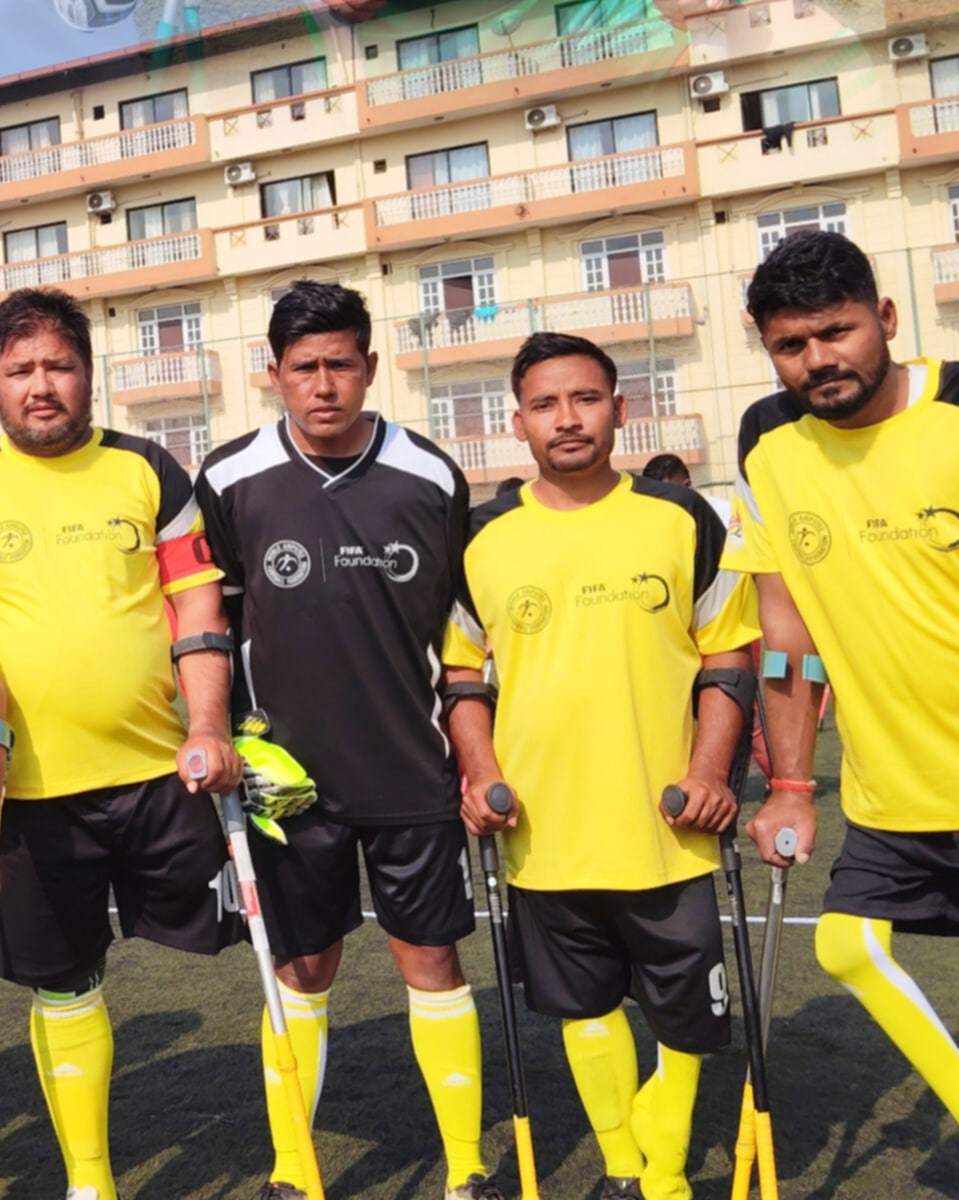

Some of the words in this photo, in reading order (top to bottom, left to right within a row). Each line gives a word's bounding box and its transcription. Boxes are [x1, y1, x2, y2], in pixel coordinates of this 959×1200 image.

[61, 524, 84, 534] FIFA
[867, 518, 889, 529] FIFA
[55, 530, 122, 546] Foundation
[859, 526, 939, 543] Foundation
[339, 545, 364, 556] FIFA
[333, 554, 398, 569] Foundation
[581, 583, 607, 595] FIFA
[575, 588, 650, 608] Foundation
[208, 860, 239, 923] 10
[708, 961, 729, 1017] 9
